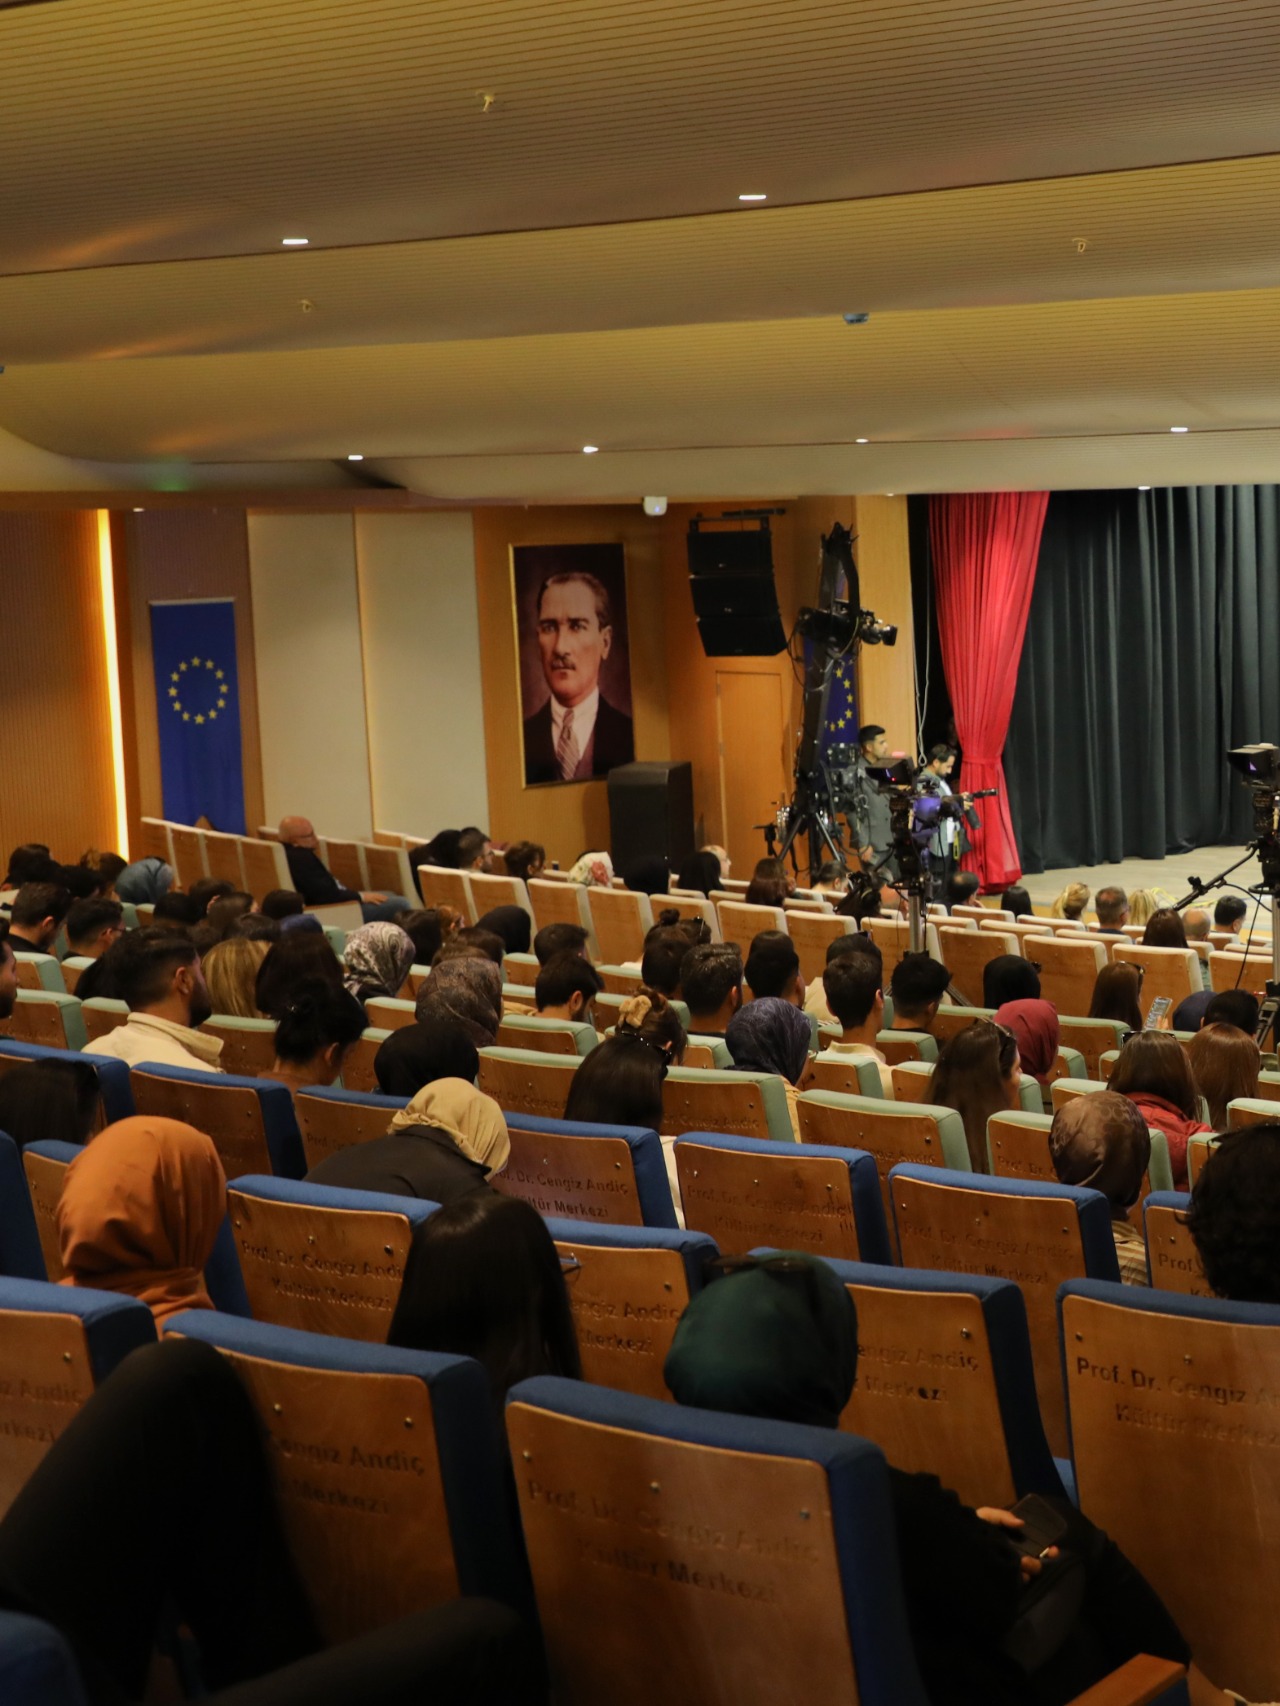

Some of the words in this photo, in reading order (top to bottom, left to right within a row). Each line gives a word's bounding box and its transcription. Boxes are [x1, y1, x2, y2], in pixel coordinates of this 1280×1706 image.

[537, 1173, 583, 1192] Cengiz
[586, 1178, 629, 1195] Andiç
[555, 1200, 609, 1217] Merkezi
[363, 1262, 403, 1282] Andi
[571, 1299, 619, 1319] engiz
[857, 1343, 908, 1368] engiz
[1076, 1356, 1125, 1385] Prof.
[1131, 1367, 1162, 1392] Dr.
[1168, 1374, 1247, 1406] Cengiz
[0, 1419, 56, 1443] rkezi
[276, 1436, 341, 1468] engiz
[349, 1445, 426, 1476] Andiç
